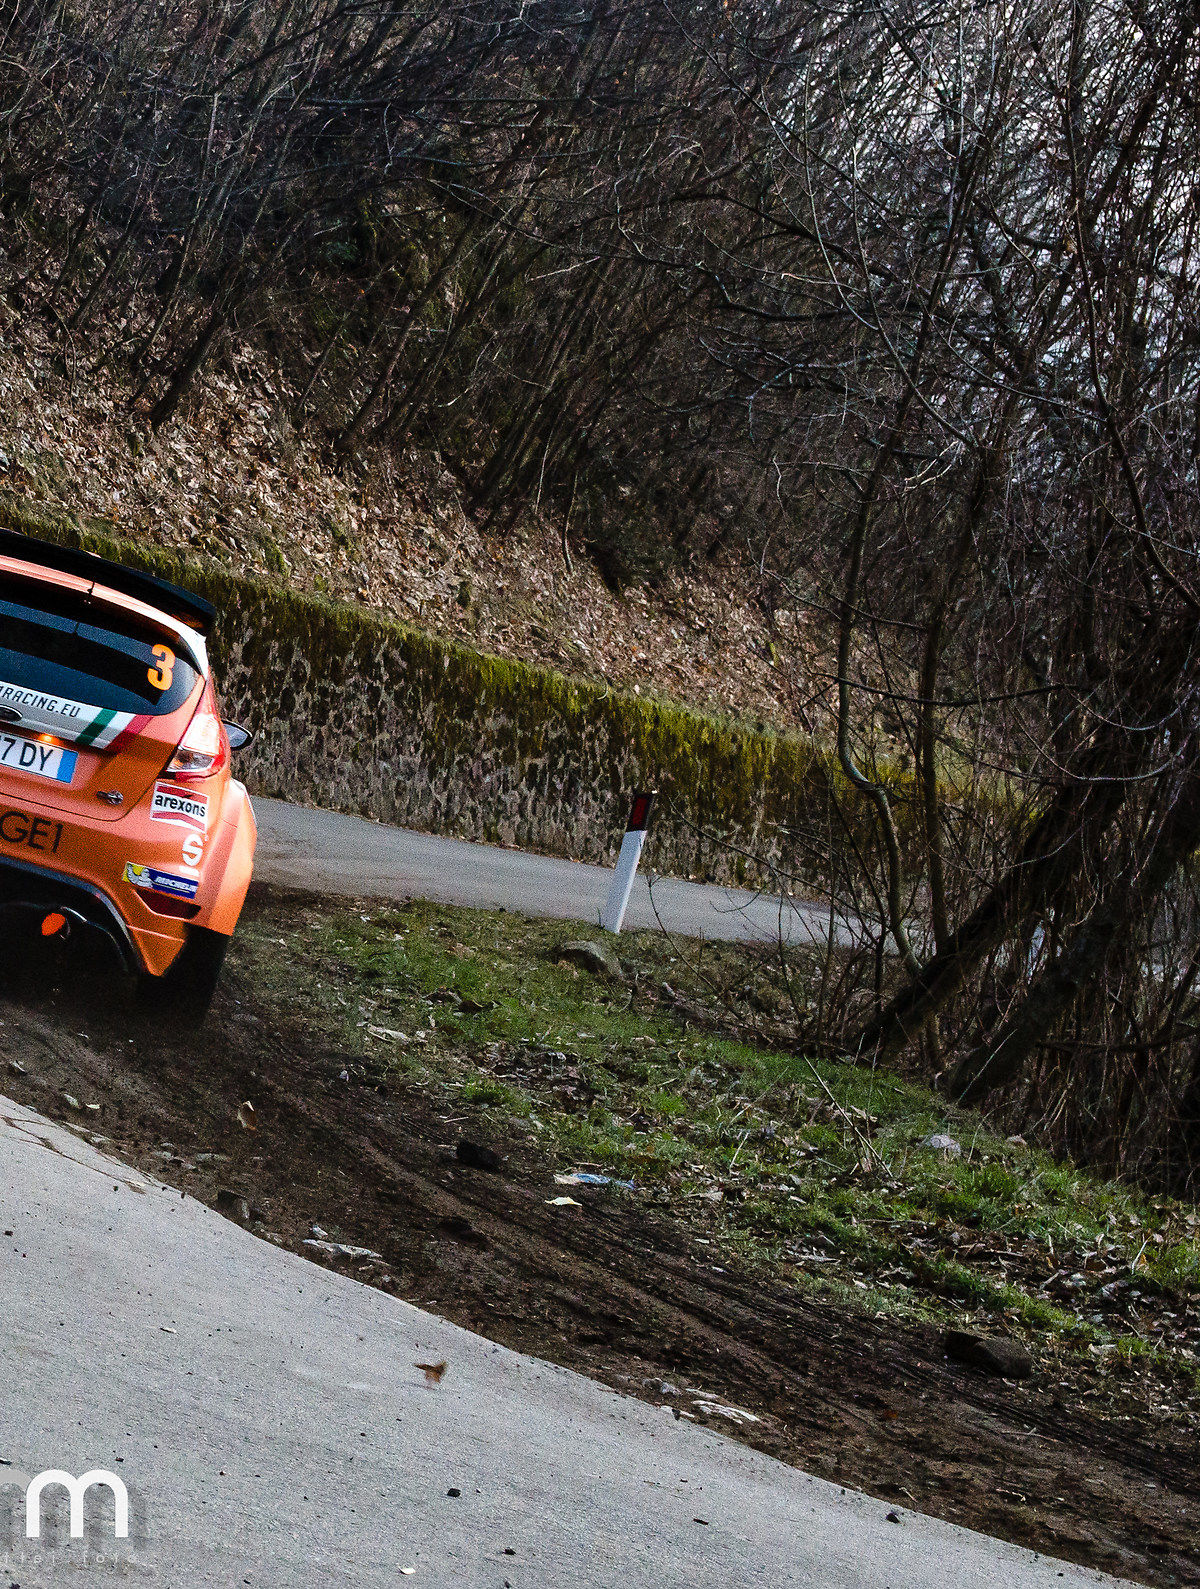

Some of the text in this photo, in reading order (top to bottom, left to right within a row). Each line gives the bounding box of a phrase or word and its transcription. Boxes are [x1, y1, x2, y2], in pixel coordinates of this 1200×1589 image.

[147, 643, 176, 691] 3
[18, 741, 54, 772] DY
[154, 793, 207, 818] arexons
